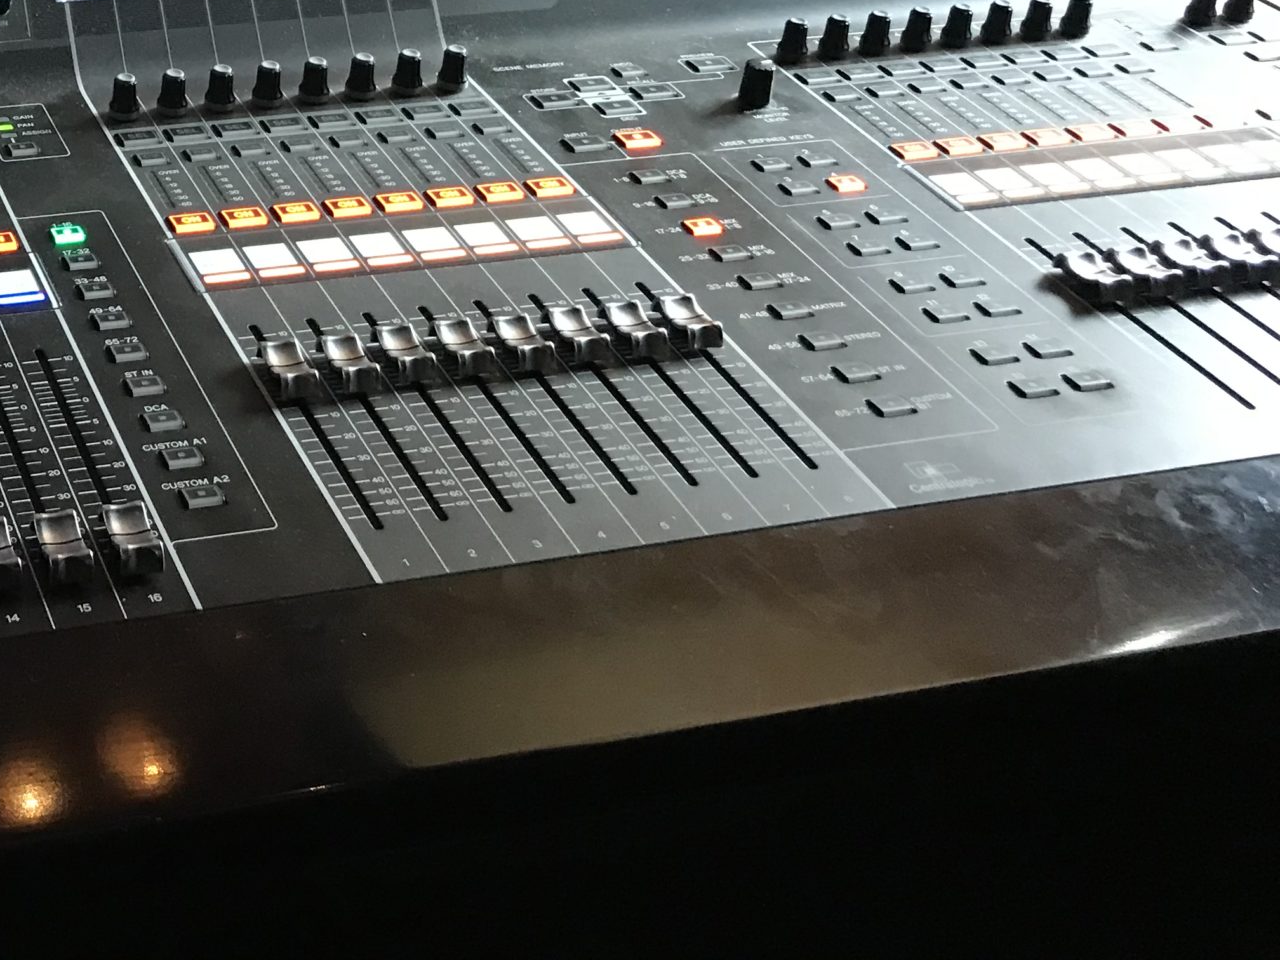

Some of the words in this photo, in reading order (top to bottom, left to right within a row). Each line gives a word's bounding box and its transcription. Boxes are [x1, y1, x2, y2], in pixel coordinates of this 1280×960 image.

[492, 64, 524, 72] SCENE
[525, 61, 565, 70] MEMORY
[746, 136, 788, 145] DEFINED
[285, 204, 307, 213] ON
[337, 199, 358, 208] ON
[233, 210, 255, 218] ON
[181, 215, 203, 224] ON
[62, 248, 91, 256] 17-32
[74, 276, 108, 285] 33-48
[783, 276, 811, 284] 17-24
[706, 282, 738, 291] 33-40
[89, 305, 123, 314] 49-64
[811, 301, 847, 311] MATRIX
[739, 311, 769, 320] 41-48
[105, 336, 140, 346] 65-72
[843, 331, 881, 341] STEREO
[768, 341, 801, 351] 49-56
[124, 370, 138, 379] ST
[141, 369, 154, 378] IN
[801, 373, 834, 383] 57-64
[144, 403, 169, 413] DCA
[142, 439, 190, 452] CUSTOM
[192, 437, 207, 446] A1
[161, 478, 209, 491] CUSTOM
[212, 475, 230, 484] A2
[597, 530, 607, 540] 4
[531, 539, 543, 548] 3
[467, 548, 477, 557] 2
[147, 592, 163, 603] 16
[76, 602, 92, 613] 15
[5, 613, 21, 623] 14
